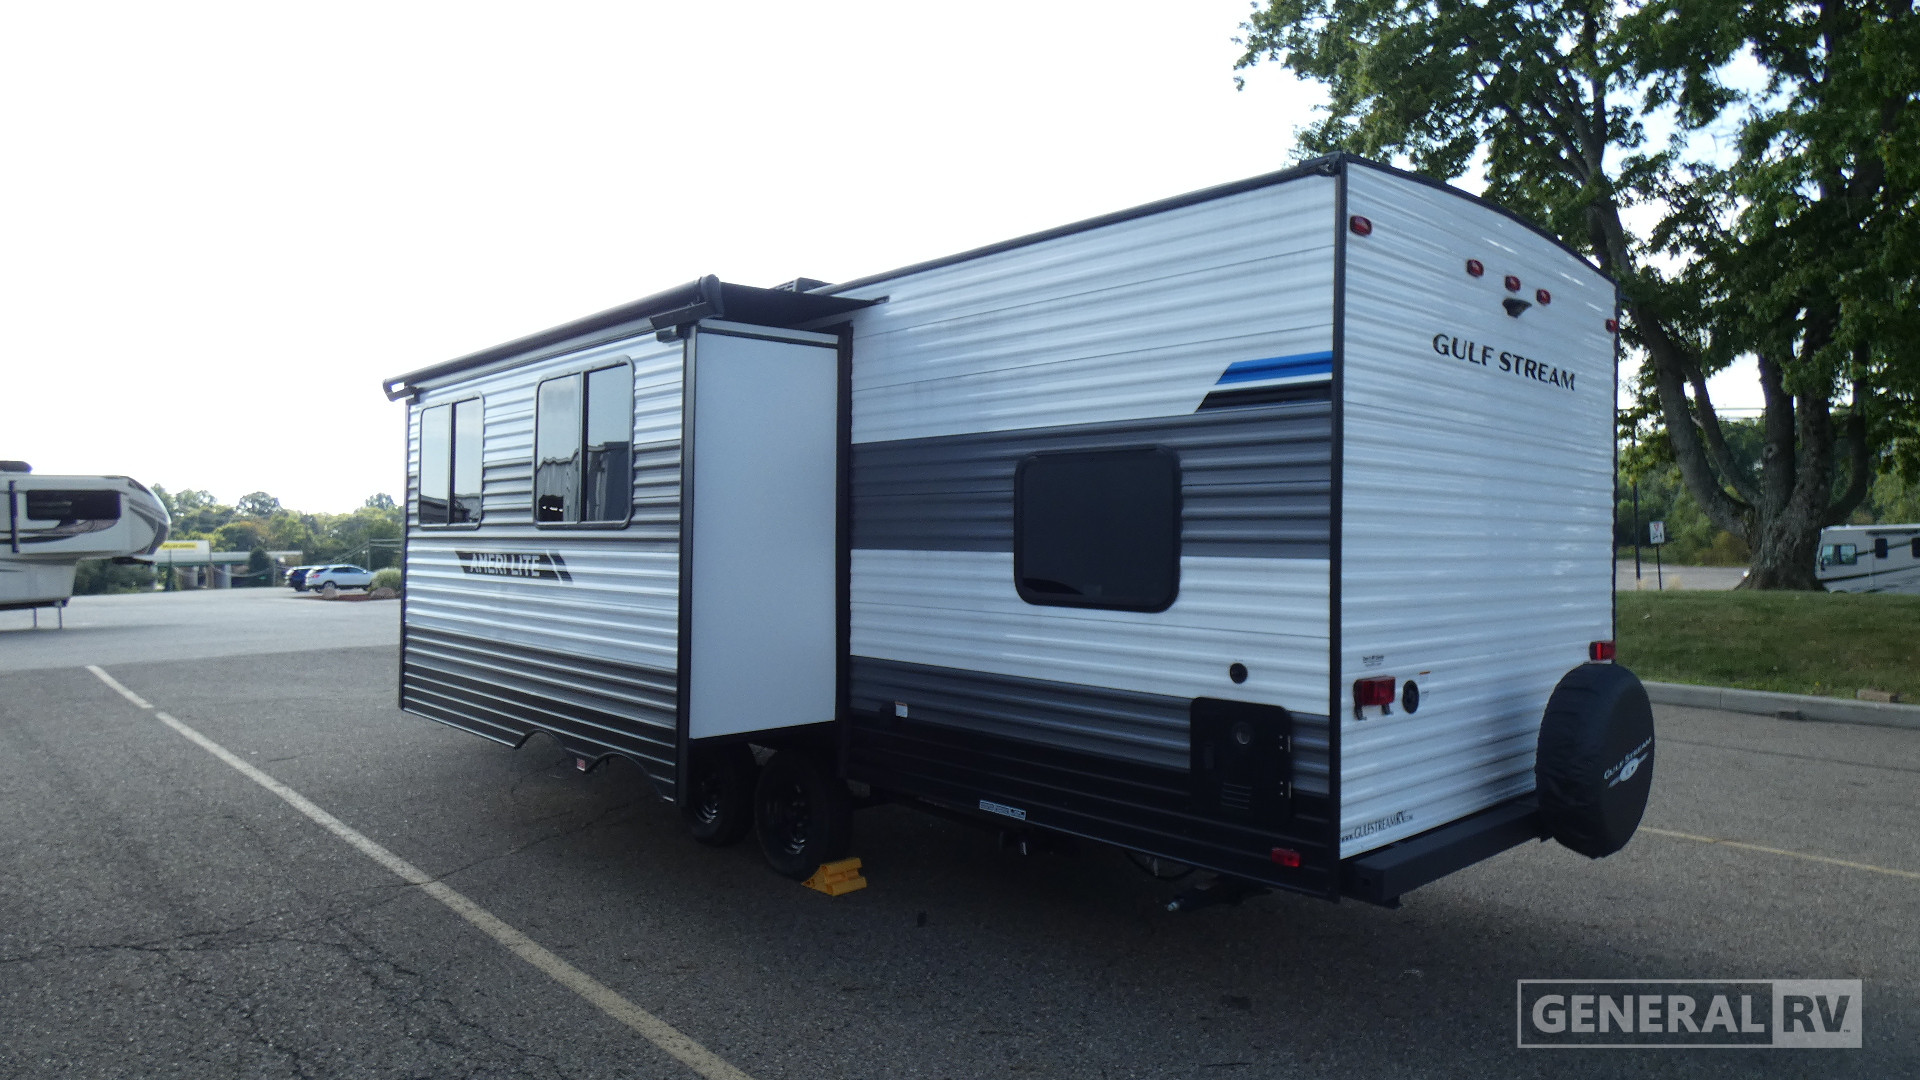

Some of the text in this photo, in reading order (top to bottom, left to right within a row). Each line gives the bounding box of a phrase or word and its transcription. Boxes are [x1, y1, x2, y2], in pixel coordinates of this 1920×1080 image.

[1432, 333, 1575, 391] GULF STREAM
[470, 553, 540, 577] AMERI LITE
